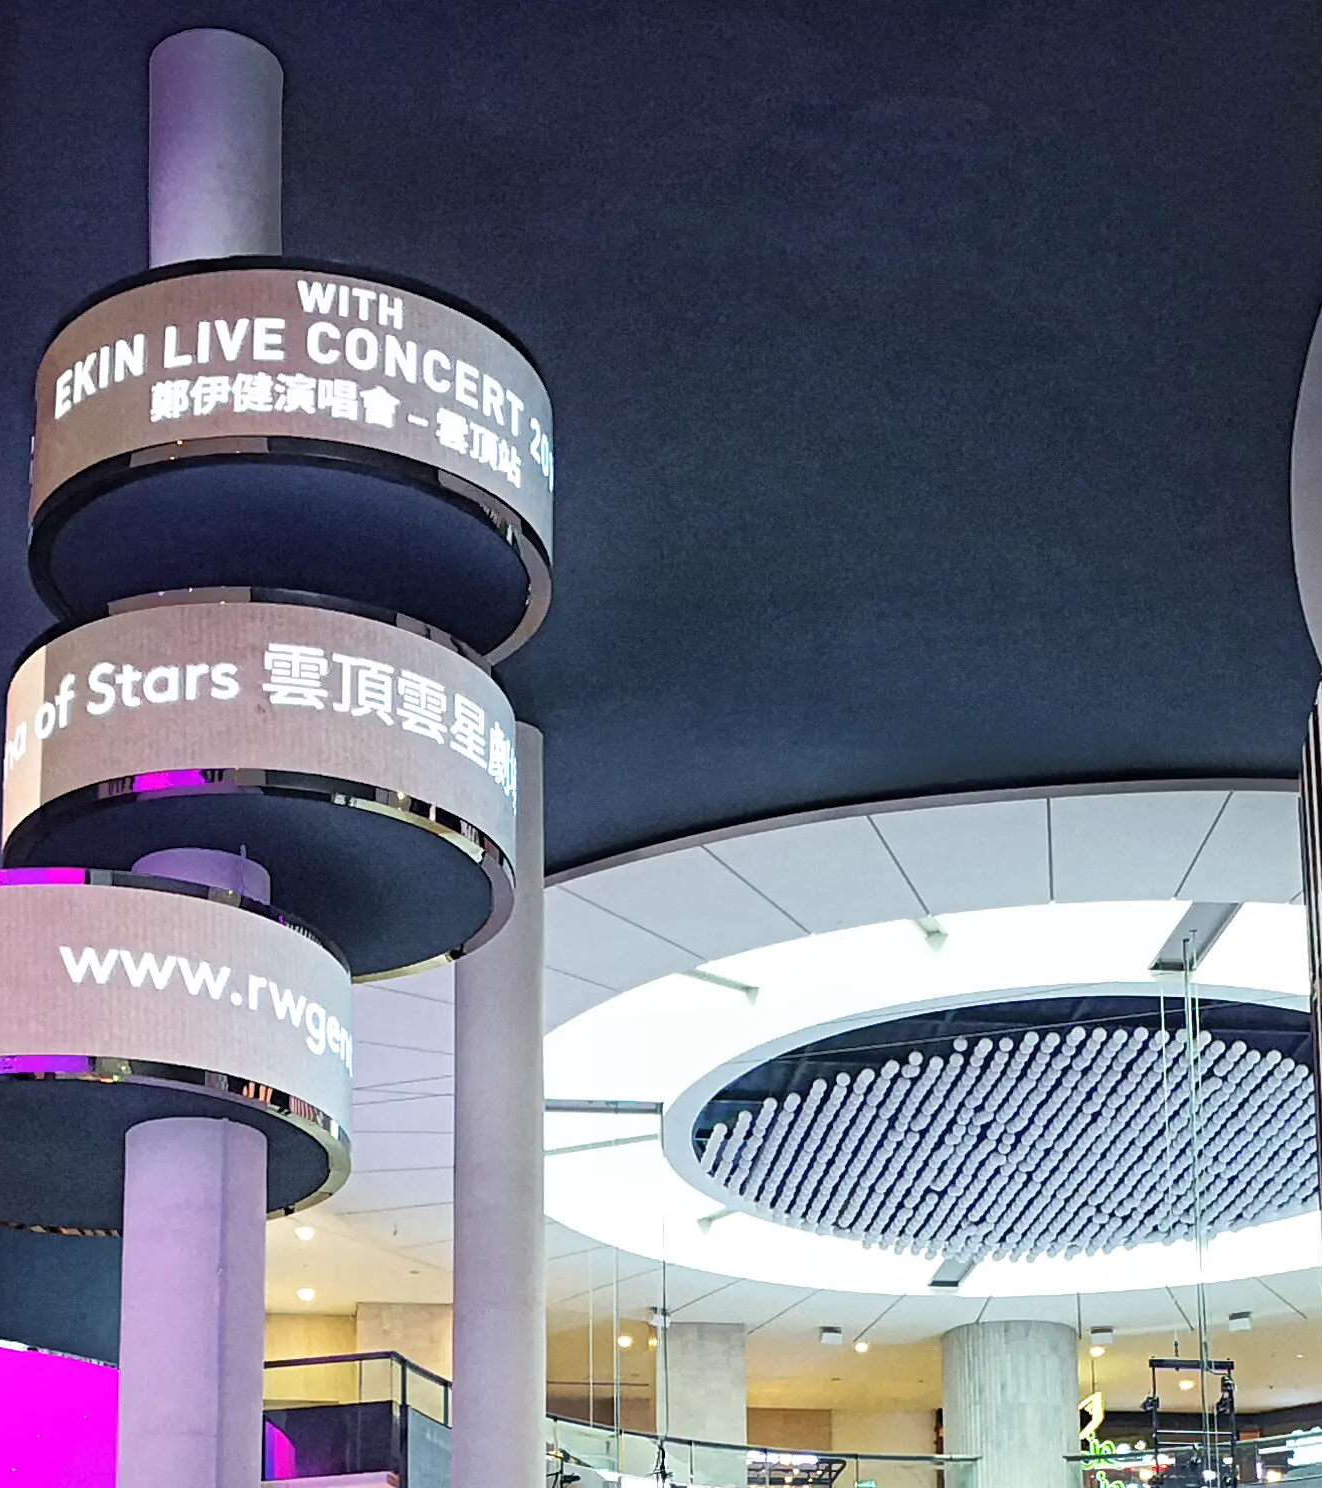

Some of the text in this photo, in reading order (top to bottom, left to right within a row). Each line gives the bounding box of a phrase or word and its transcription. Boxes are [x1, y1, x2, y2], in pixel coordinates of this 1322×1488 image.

[297, 280, 405, 330] WITH
[54, 333, 147, 420] EKIN
[163, 318, 285, 369] LIVE
[306, 321, 525, 437] CONCERT
[34, 672, 76, 740] of
[85, 661, 240, 718] Stars
